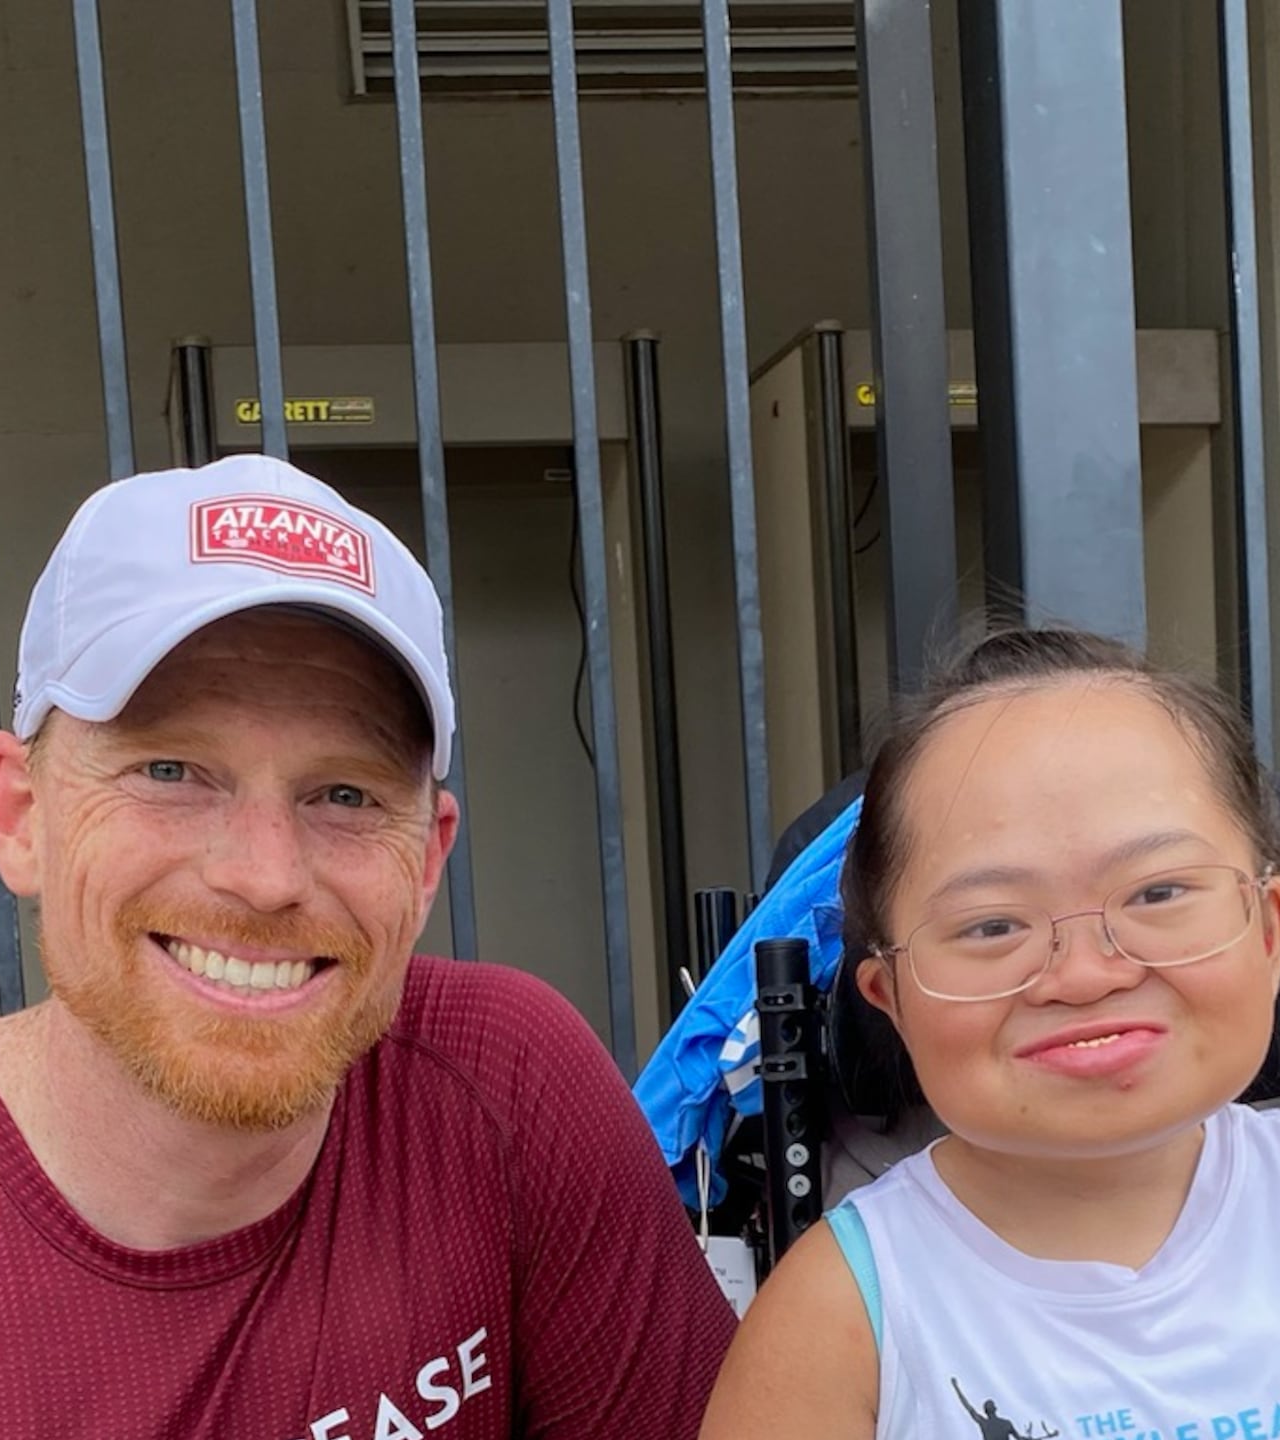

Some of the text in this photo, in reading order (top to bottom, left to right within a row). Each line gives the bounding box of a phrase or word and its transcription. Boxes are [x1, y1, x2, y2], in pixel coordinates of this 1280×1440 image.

[237, 401, 330, 422] GARETT
[212, 507, 357, 555] ATLANTA
[212, 528, 289, 544] TRACK
[1077, 1408, 1136, 1438] THE
